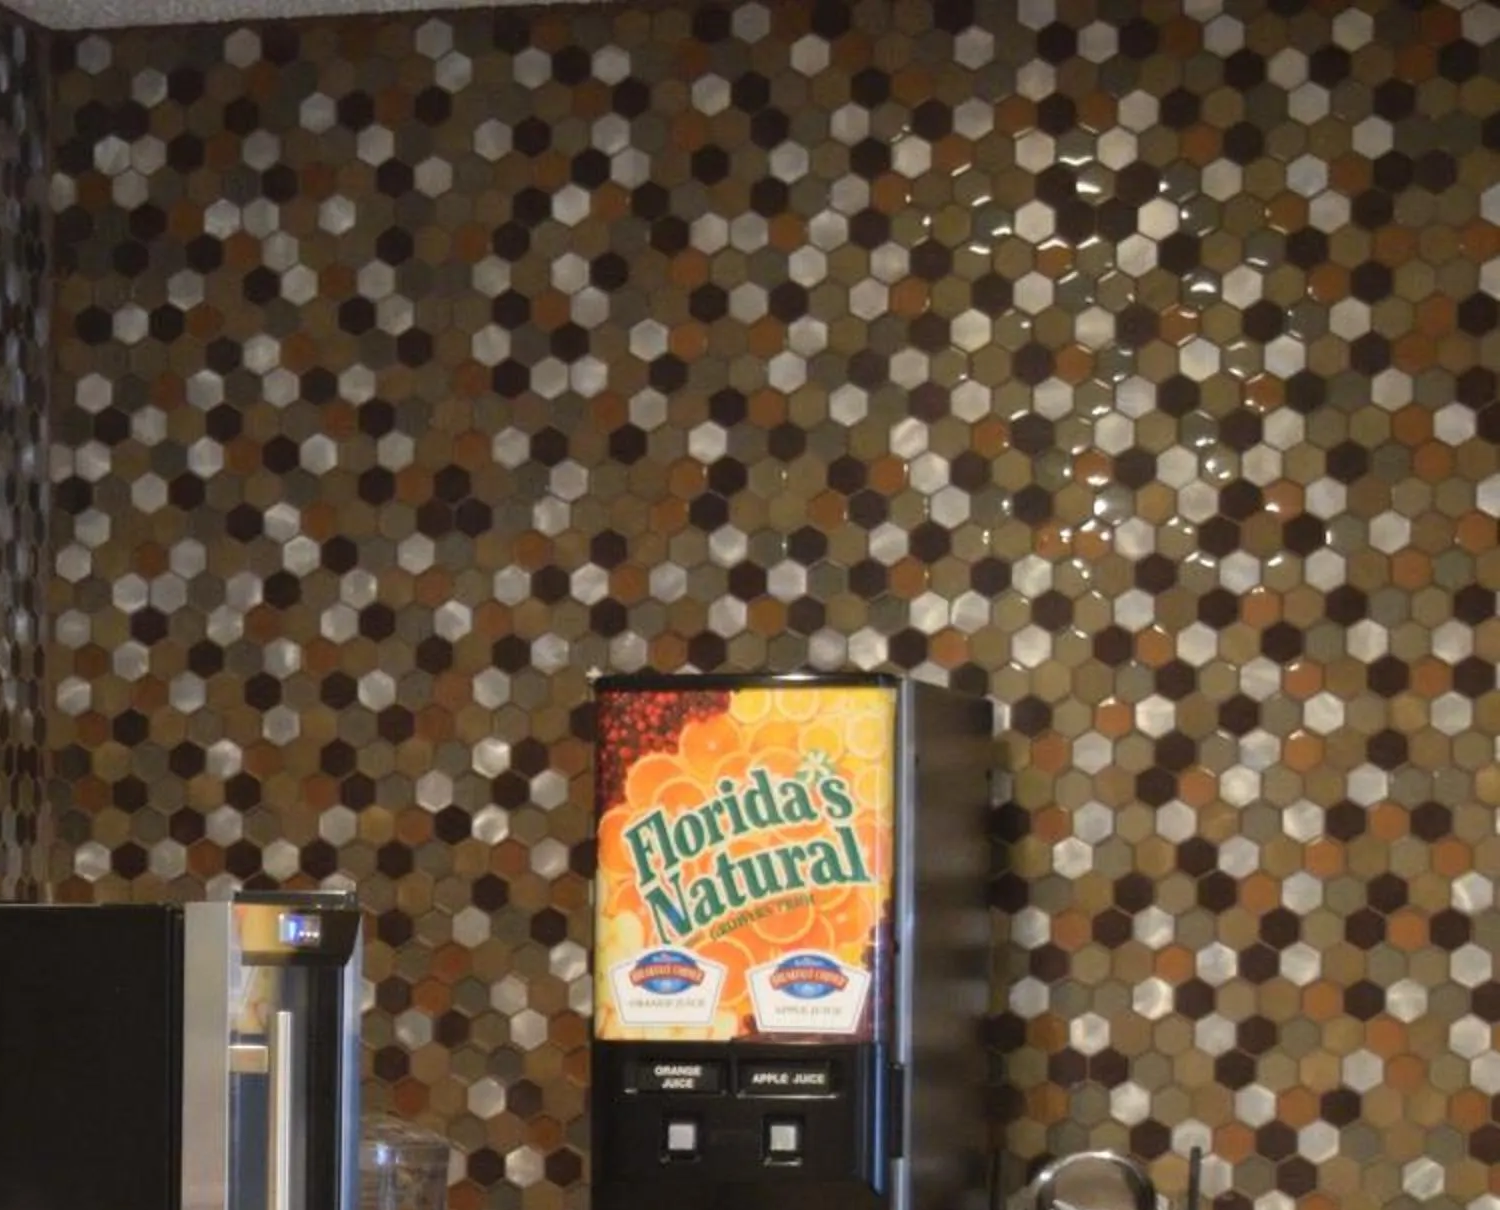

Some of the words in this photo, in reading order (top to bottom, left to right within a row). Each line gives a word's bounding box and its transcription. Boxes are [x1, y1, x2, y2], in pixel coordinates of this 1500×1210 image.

[624, 764, 854, 886] Florida's
[644, 824, 872, 945] Natural
[654, 1065, 701, 1077] ORANGE
[662, 1078, 693, 1089] JUICE
[752, 1072, 788, 1085] APPLE
[792, 1073, 825, 1085] JUICE
